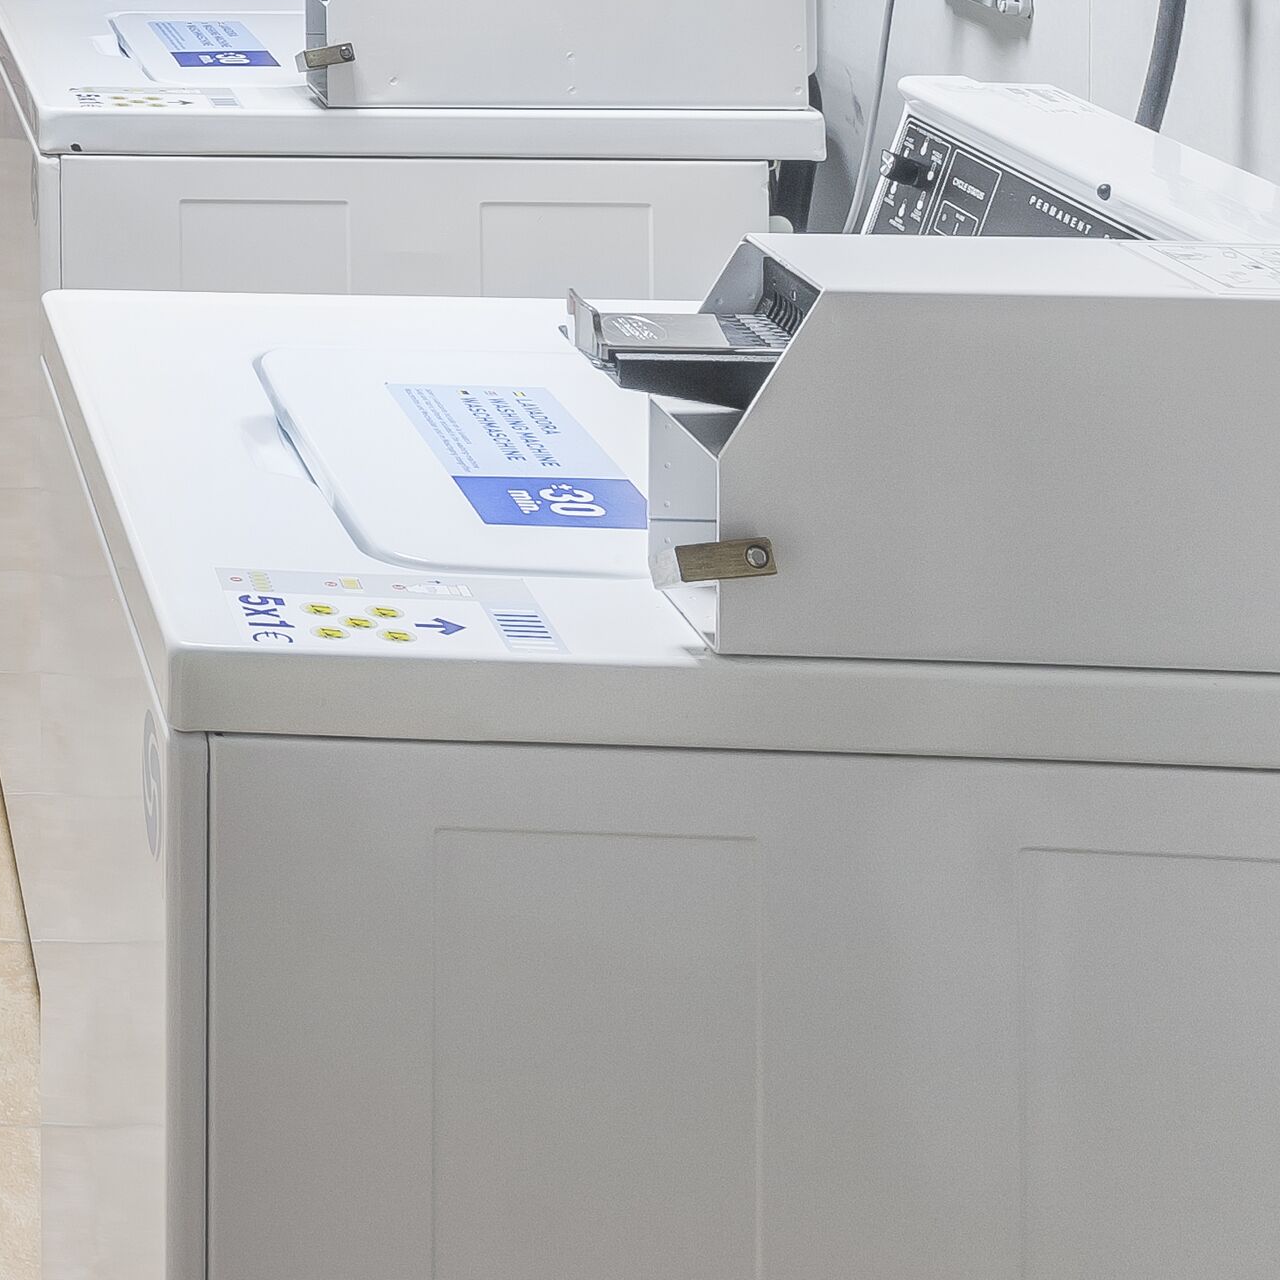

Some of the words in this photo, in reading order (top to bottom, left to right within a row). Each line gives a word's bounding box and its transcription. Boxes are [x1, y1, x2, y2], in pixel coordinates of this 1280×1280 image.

[1028, 195, 1093, 236] PERMANENT
[460, 397, 527, 461] WASCHMASCHINE
[488, 398, 529, 431] WASHING
[515, 431, 561, 467] MACHINE
[516, 398, 561, 435] LAVADORA
[507, 487, 538, 515] min.
